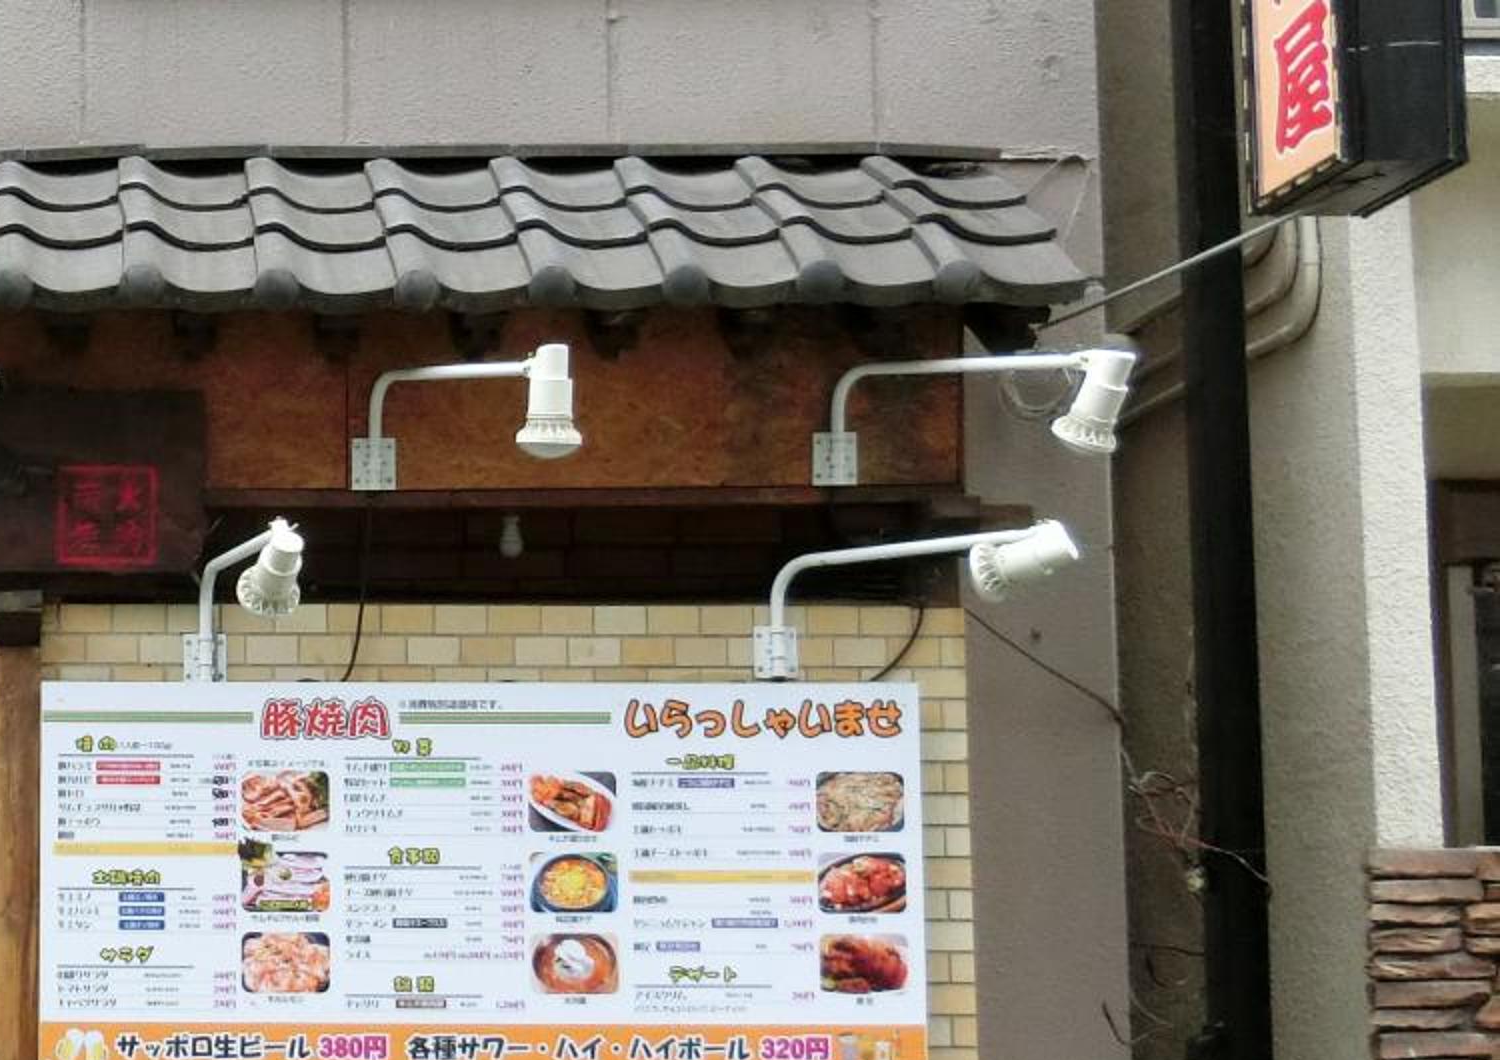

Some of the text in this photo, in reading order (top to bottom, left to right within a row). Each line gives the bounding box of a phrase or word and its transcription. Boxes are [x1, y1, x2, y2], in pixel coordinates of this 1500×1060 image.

[261, 697, 391, 740] 豚焼肉
[625, 698, 902, 739] いらっしゃいませ
[116, 1035, 829, 1060] サッポロ生ビール 380円 各種サワー・ハイ・ハイボール 320円
